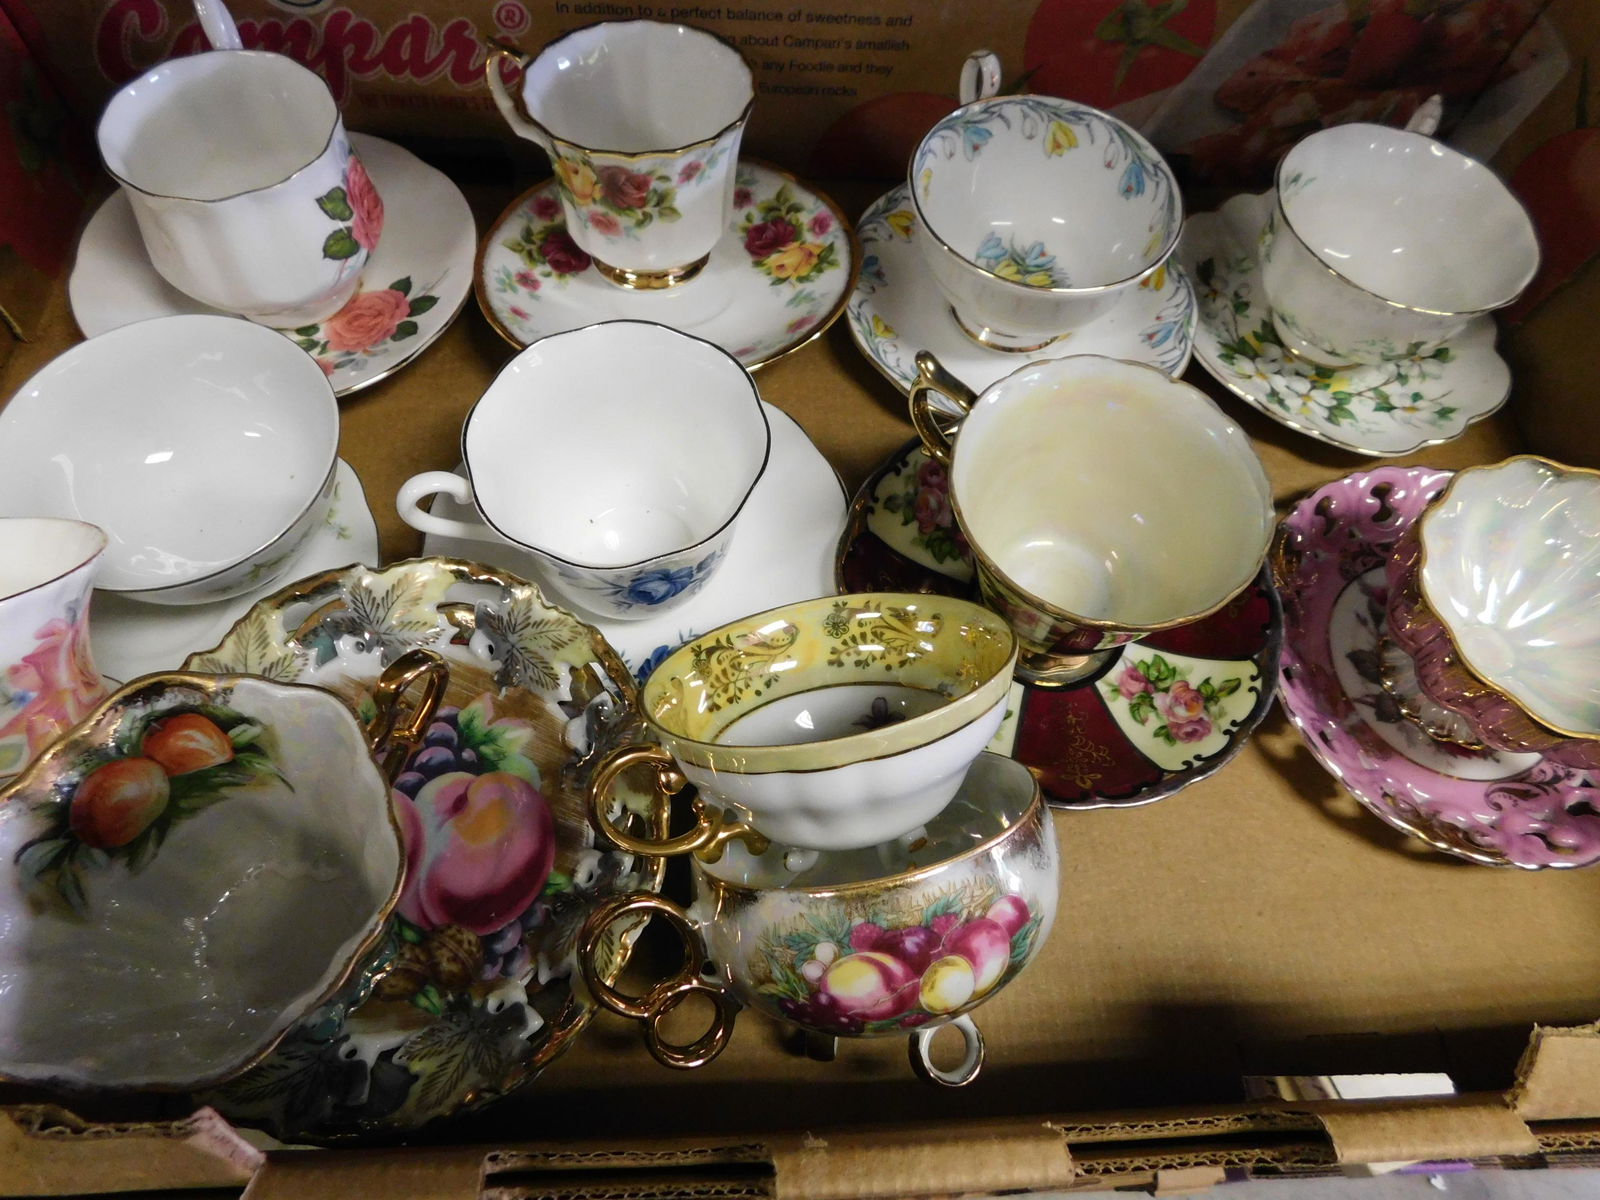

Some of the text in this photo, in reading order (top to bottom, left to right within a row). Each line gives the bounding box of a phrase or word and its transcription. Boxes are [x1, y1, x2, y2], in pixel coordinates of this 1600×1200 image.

[556, 2, 912, 27] In addition to a perfect balance of sweetness and
[740, 34, 778, 47] about
[783, 35, 852, 50] Campari's
[762, 61, 784, 73] any
[789, 60, 833, 73] Foodie
[838, 61, 862, 73] and
[866, 63, 893, 77] they
[758, 81, 820, 96] European
